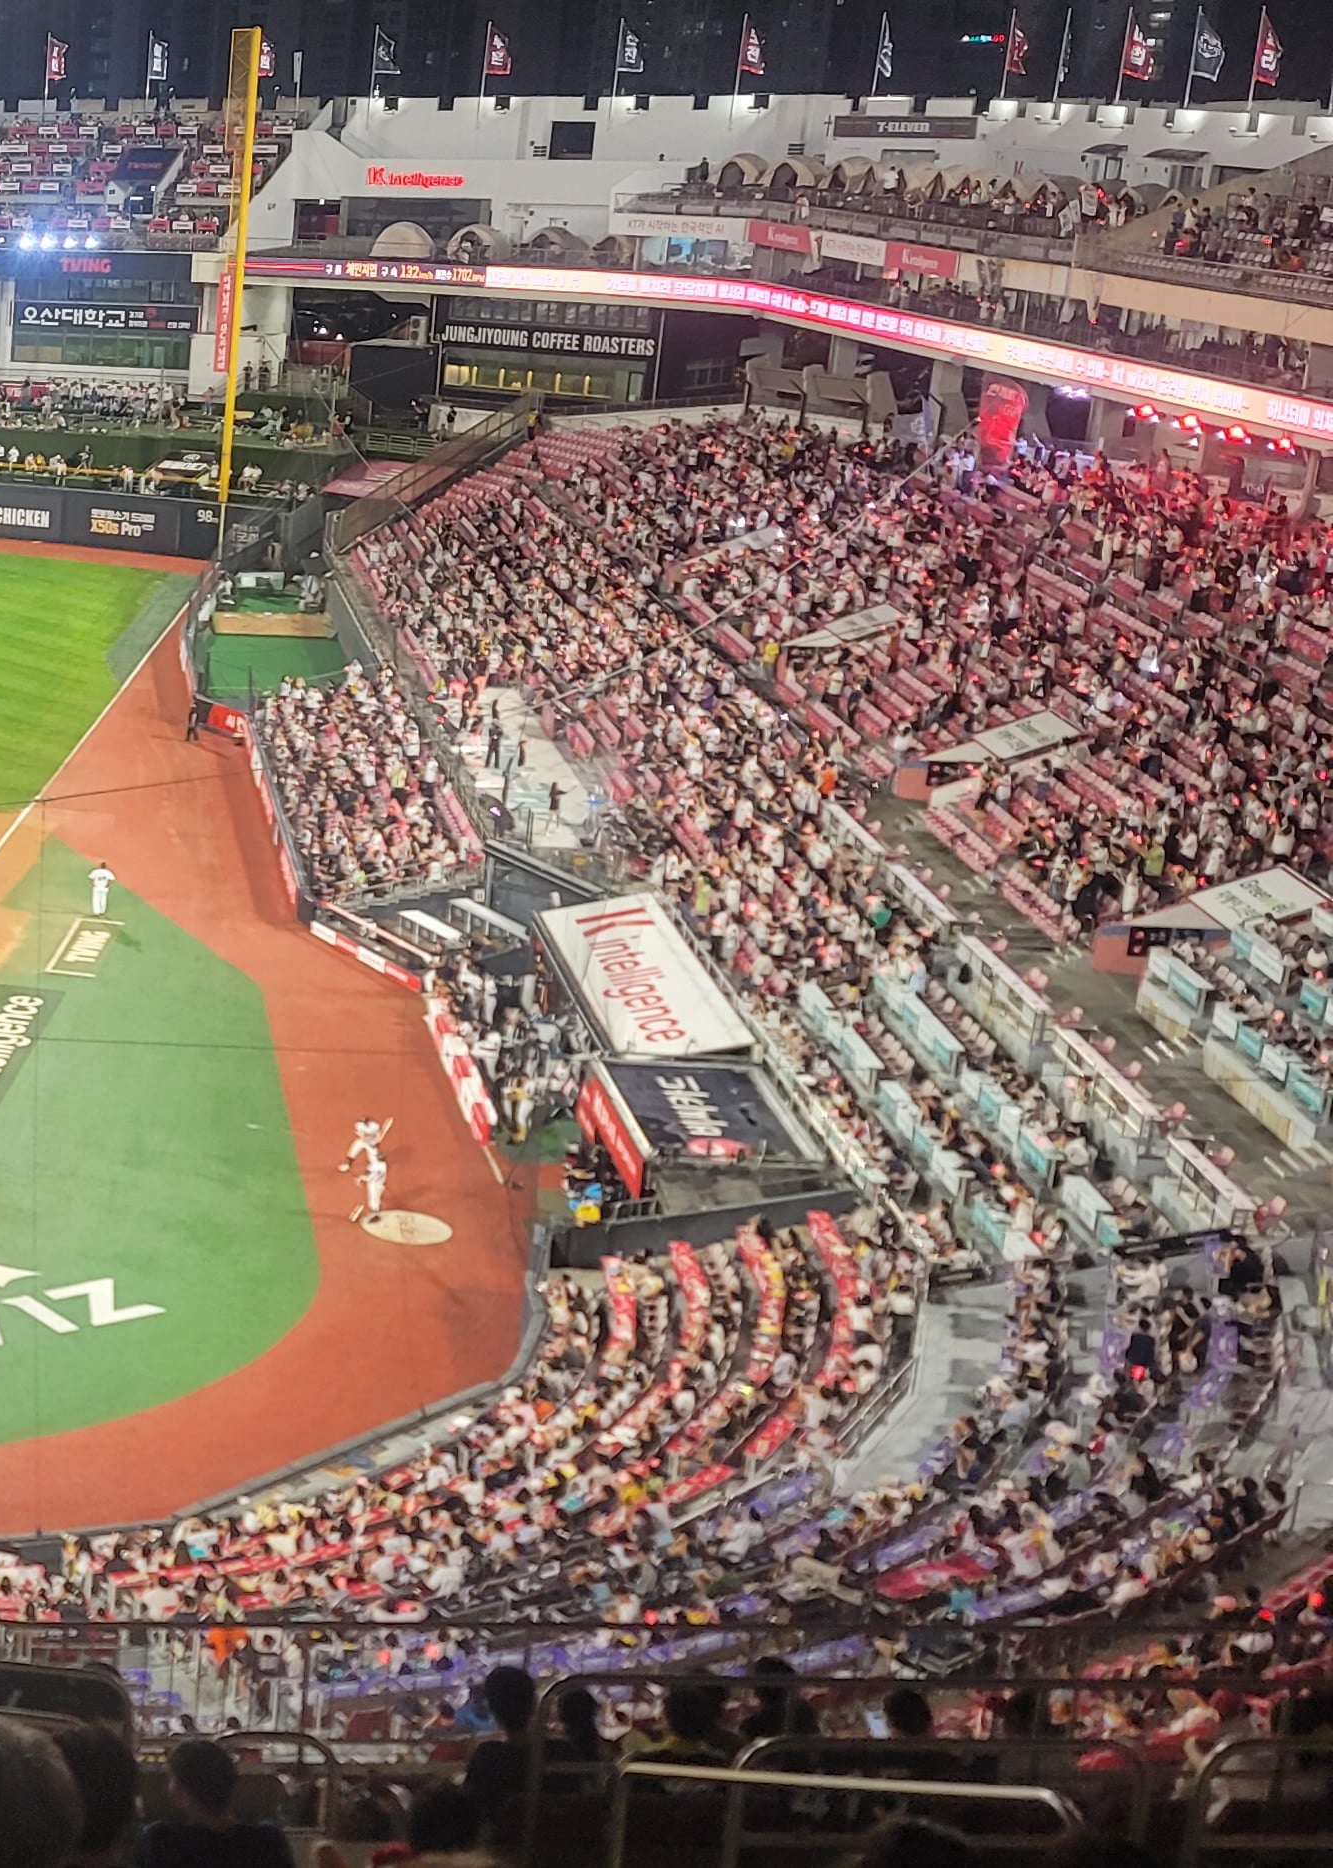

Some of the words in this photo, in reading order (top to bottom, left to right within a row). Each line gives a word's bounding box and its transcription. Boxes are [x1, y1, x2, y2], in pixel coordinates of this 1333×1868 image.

[60, 256, 112, 274] TVING
[20, 306, 125, 329] 오산대학교
[441, 325, 528, 348] JUNGJIYOUNG
[532, 330, 580, 351] COFFEE
[583, 335, 656, 357] ROASTERS
[90, 518, 120, 535] X50s
[120, 521, 142, 537] Pro
[575, 907, 656, 938] K
[63, 929, 111, 967] TVING
[601, 934, 689, 1044] intelligence
